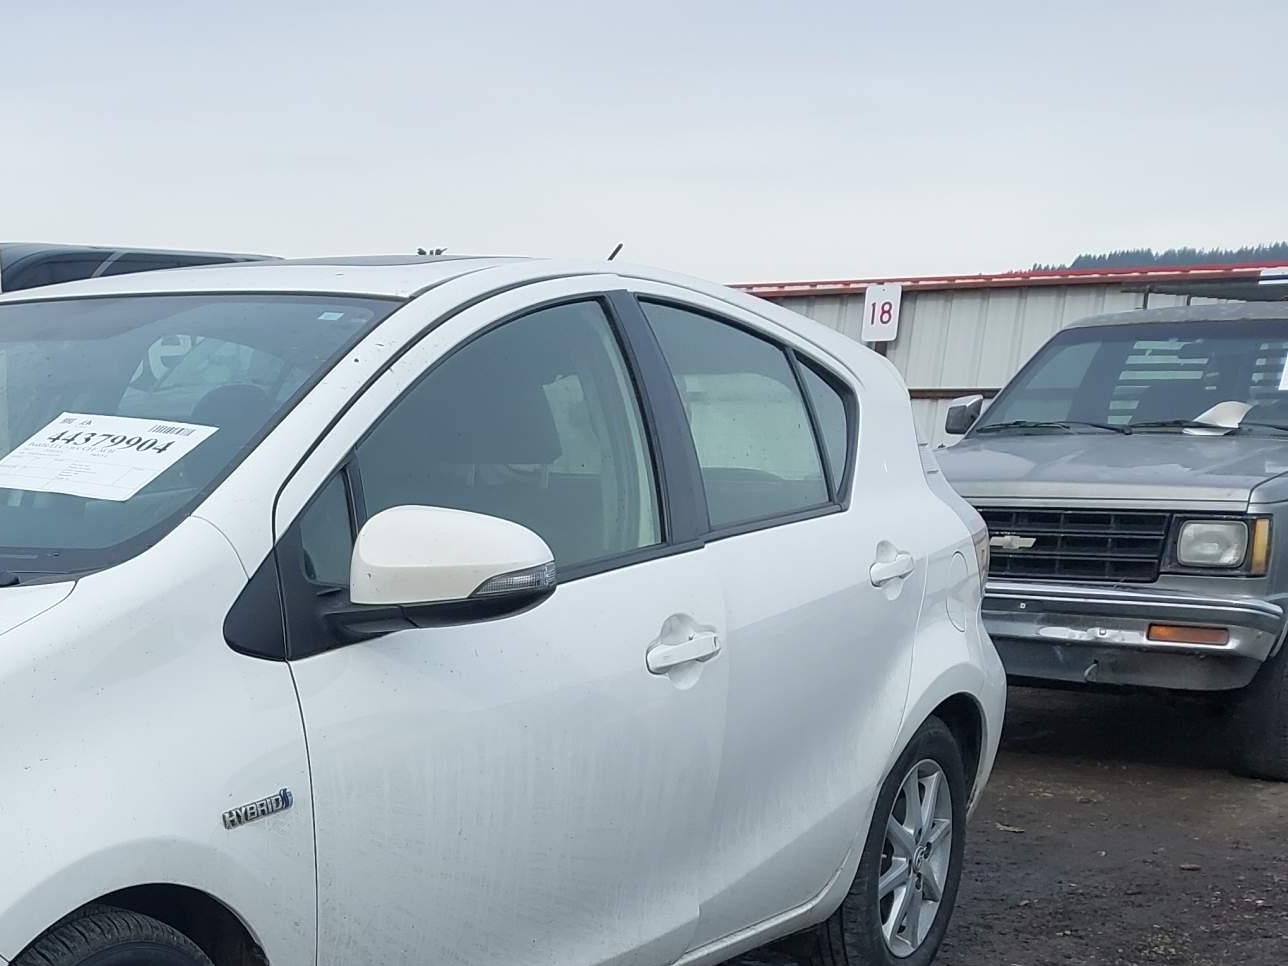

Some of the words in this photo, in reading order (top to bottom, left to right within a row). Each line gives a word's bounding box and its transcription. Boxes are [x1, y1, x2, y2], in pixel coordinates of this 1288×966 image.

[871, 301, 893, 325] 18
[48, 430, 176, 454] 44379904
[222, 794, 284, 830] HYBRID
